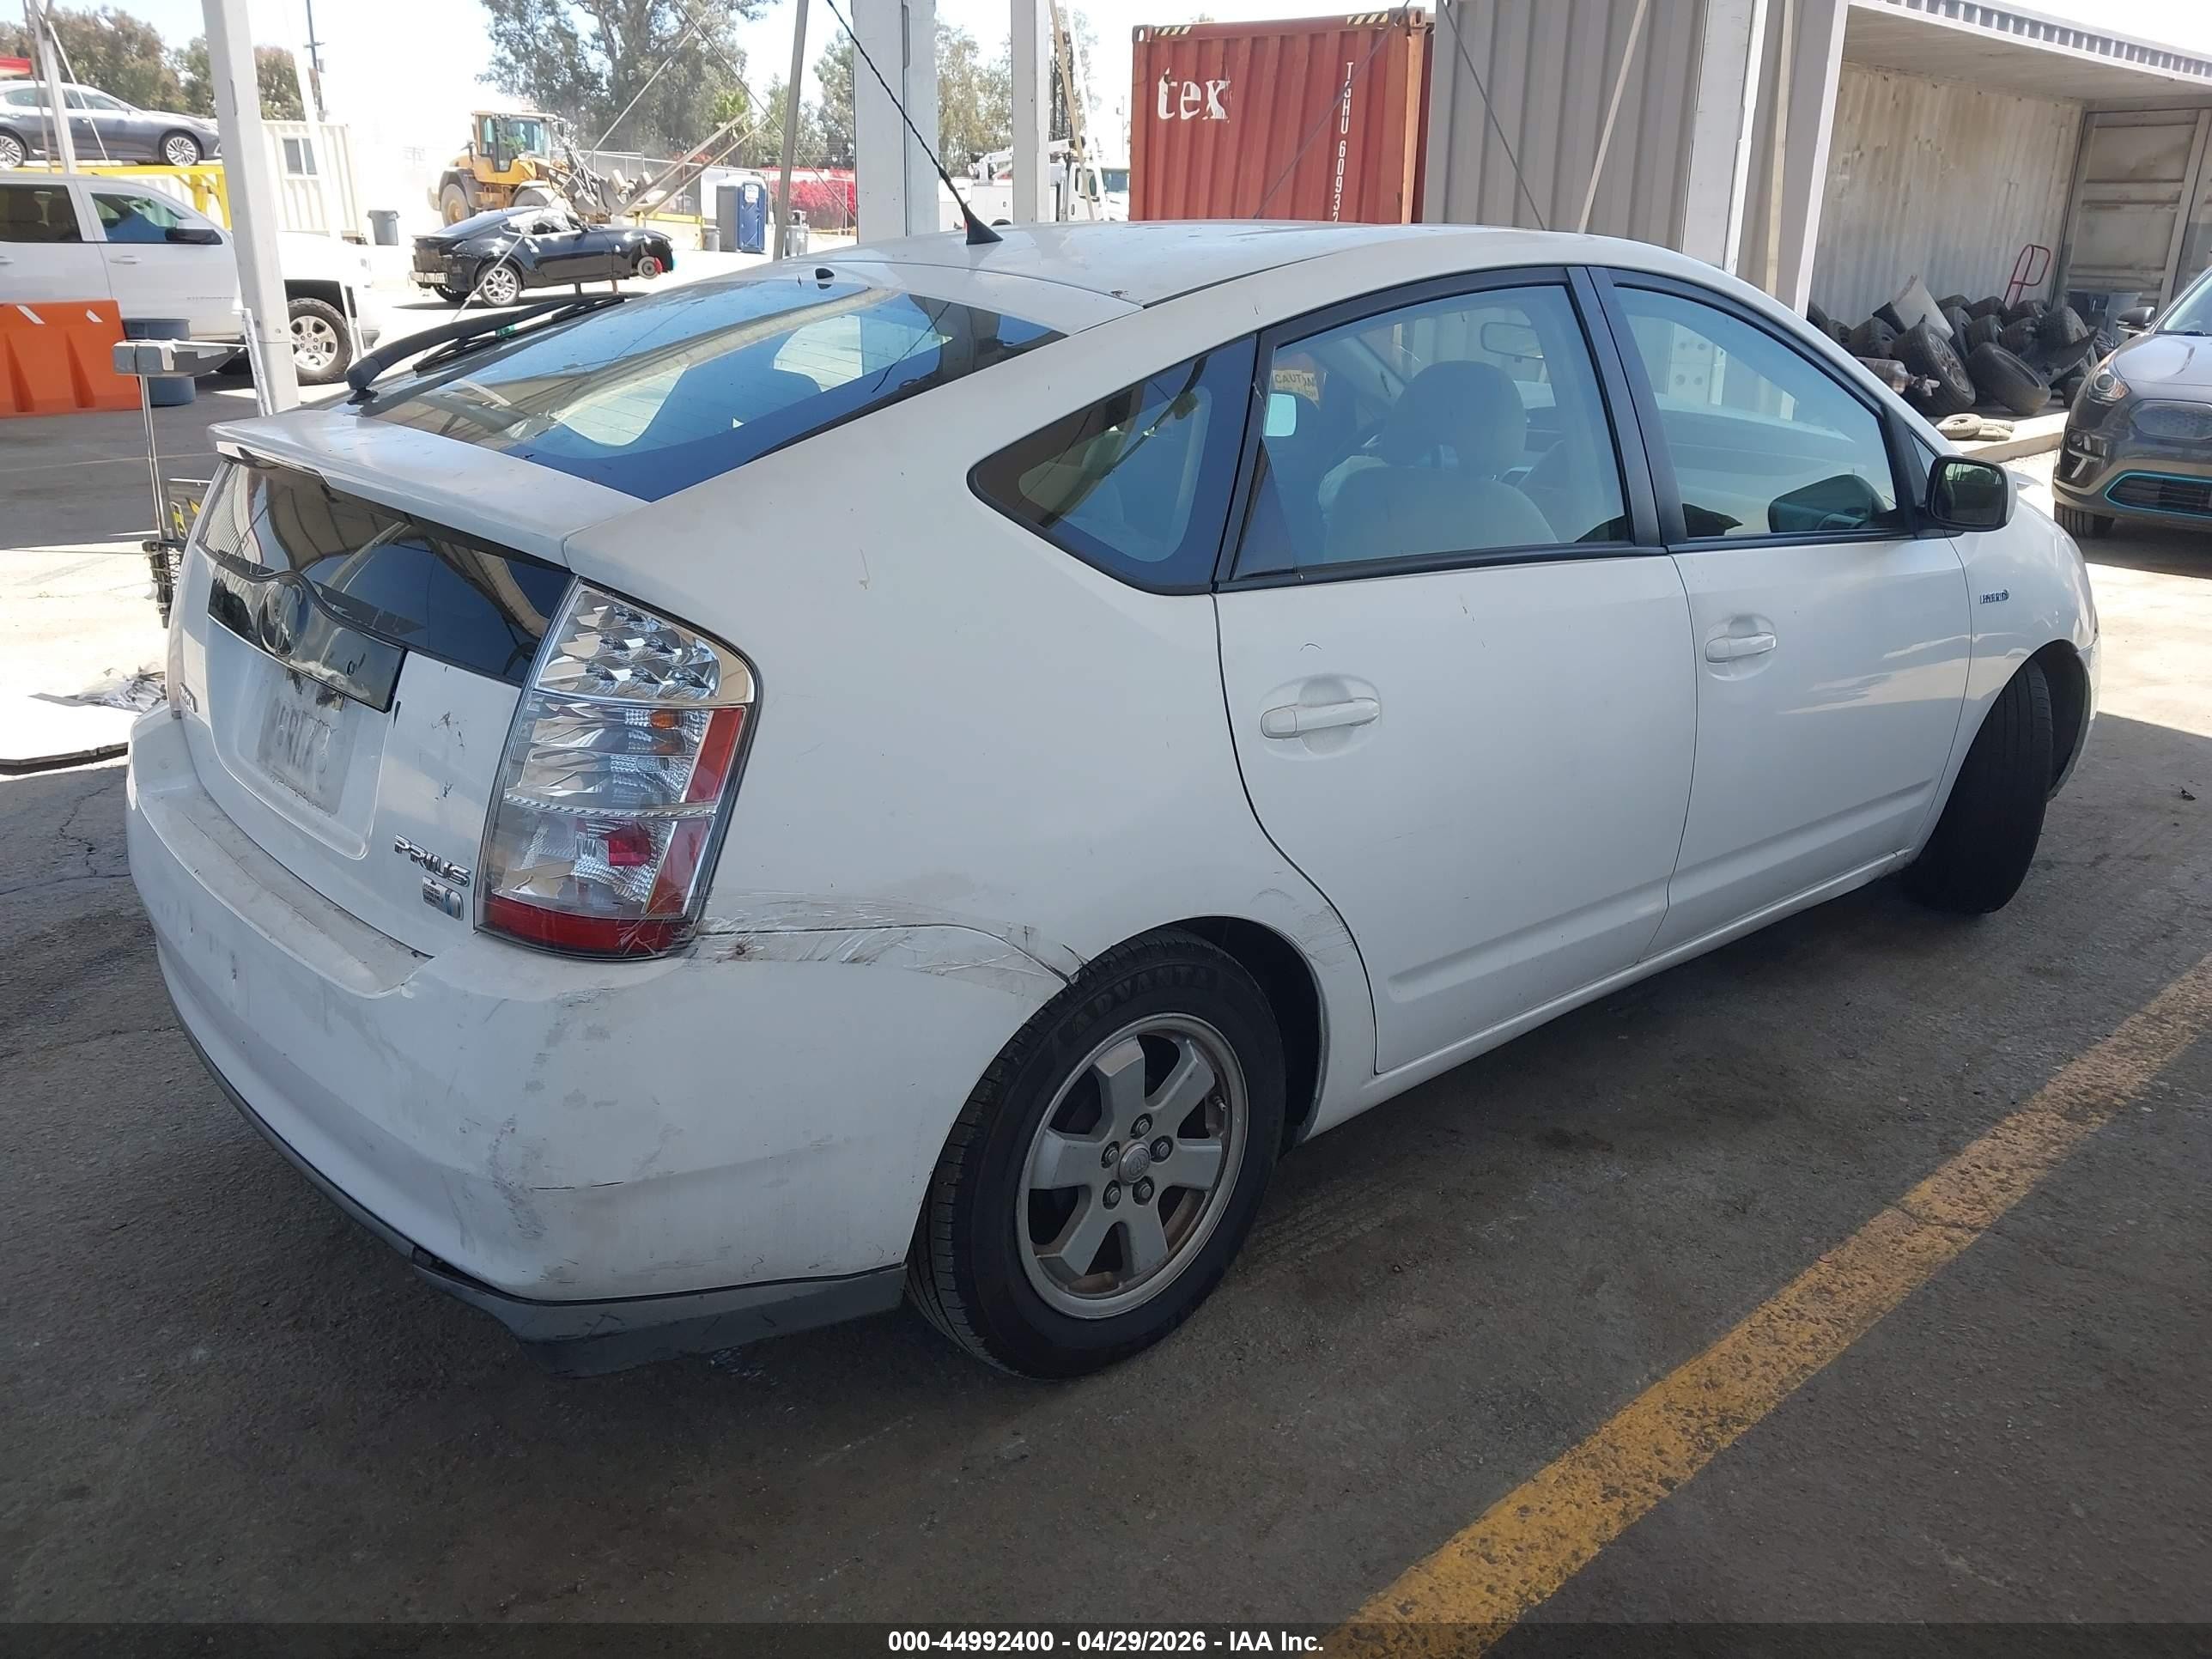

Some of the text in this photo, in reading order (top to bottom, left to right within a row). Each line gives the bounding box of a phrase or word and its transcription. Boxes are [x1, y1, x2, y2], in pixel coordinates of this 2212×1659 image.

[1158, 67, 1231, 121] tex
[1275, 374, 1315, 387] CAUTN
[395, 834, 471, 887] PRIUS
